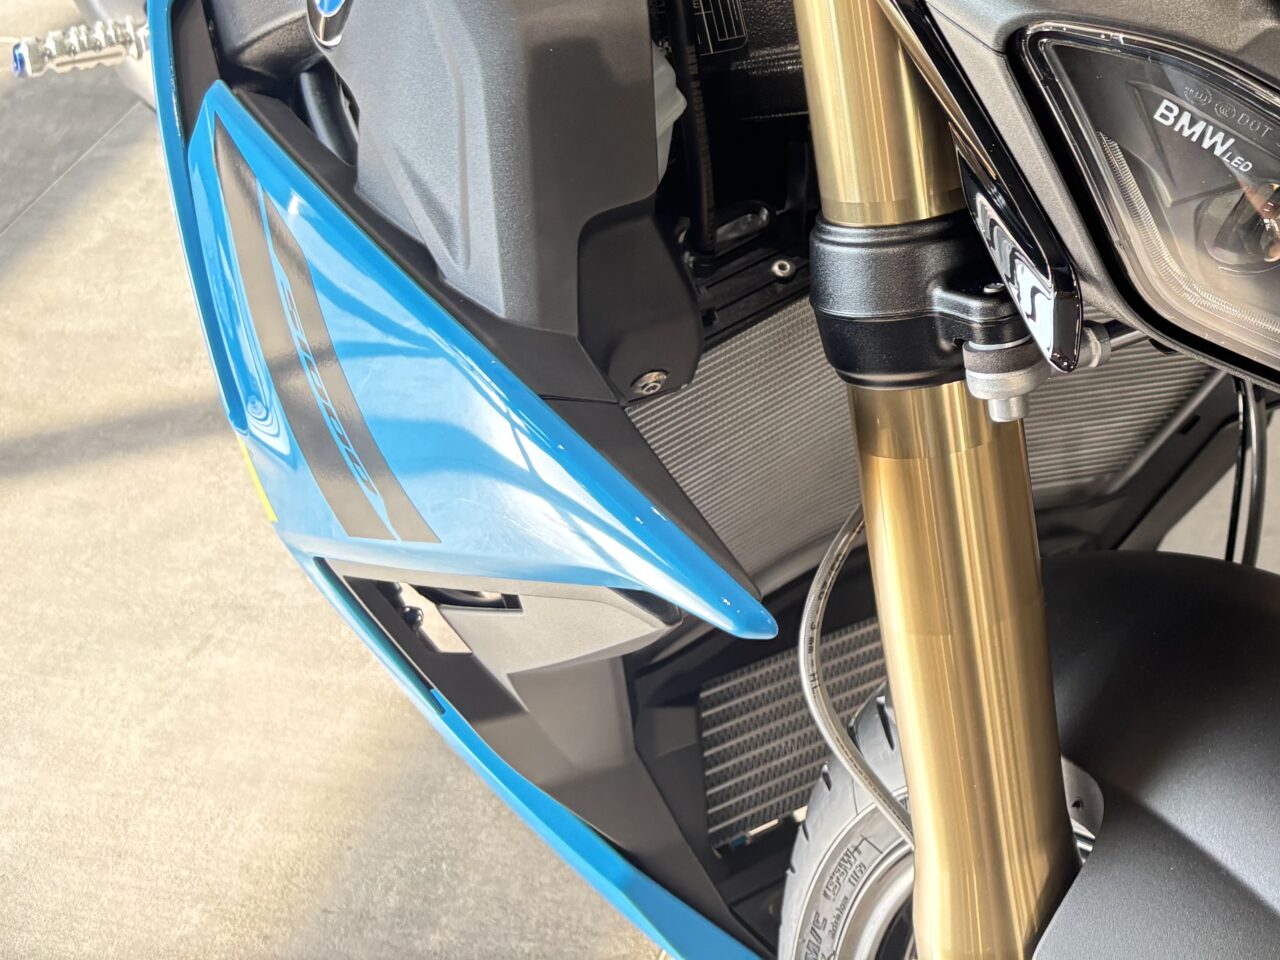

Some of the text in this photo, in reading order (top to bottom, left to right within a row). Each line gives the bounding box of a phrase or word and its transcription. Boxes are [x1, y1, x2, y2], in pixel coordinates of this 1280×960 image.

[1152, 98, 1236, 158] BMW
[1221, 150, 1254, 173] LED
[1237, 112, 1273, 138] DOT
